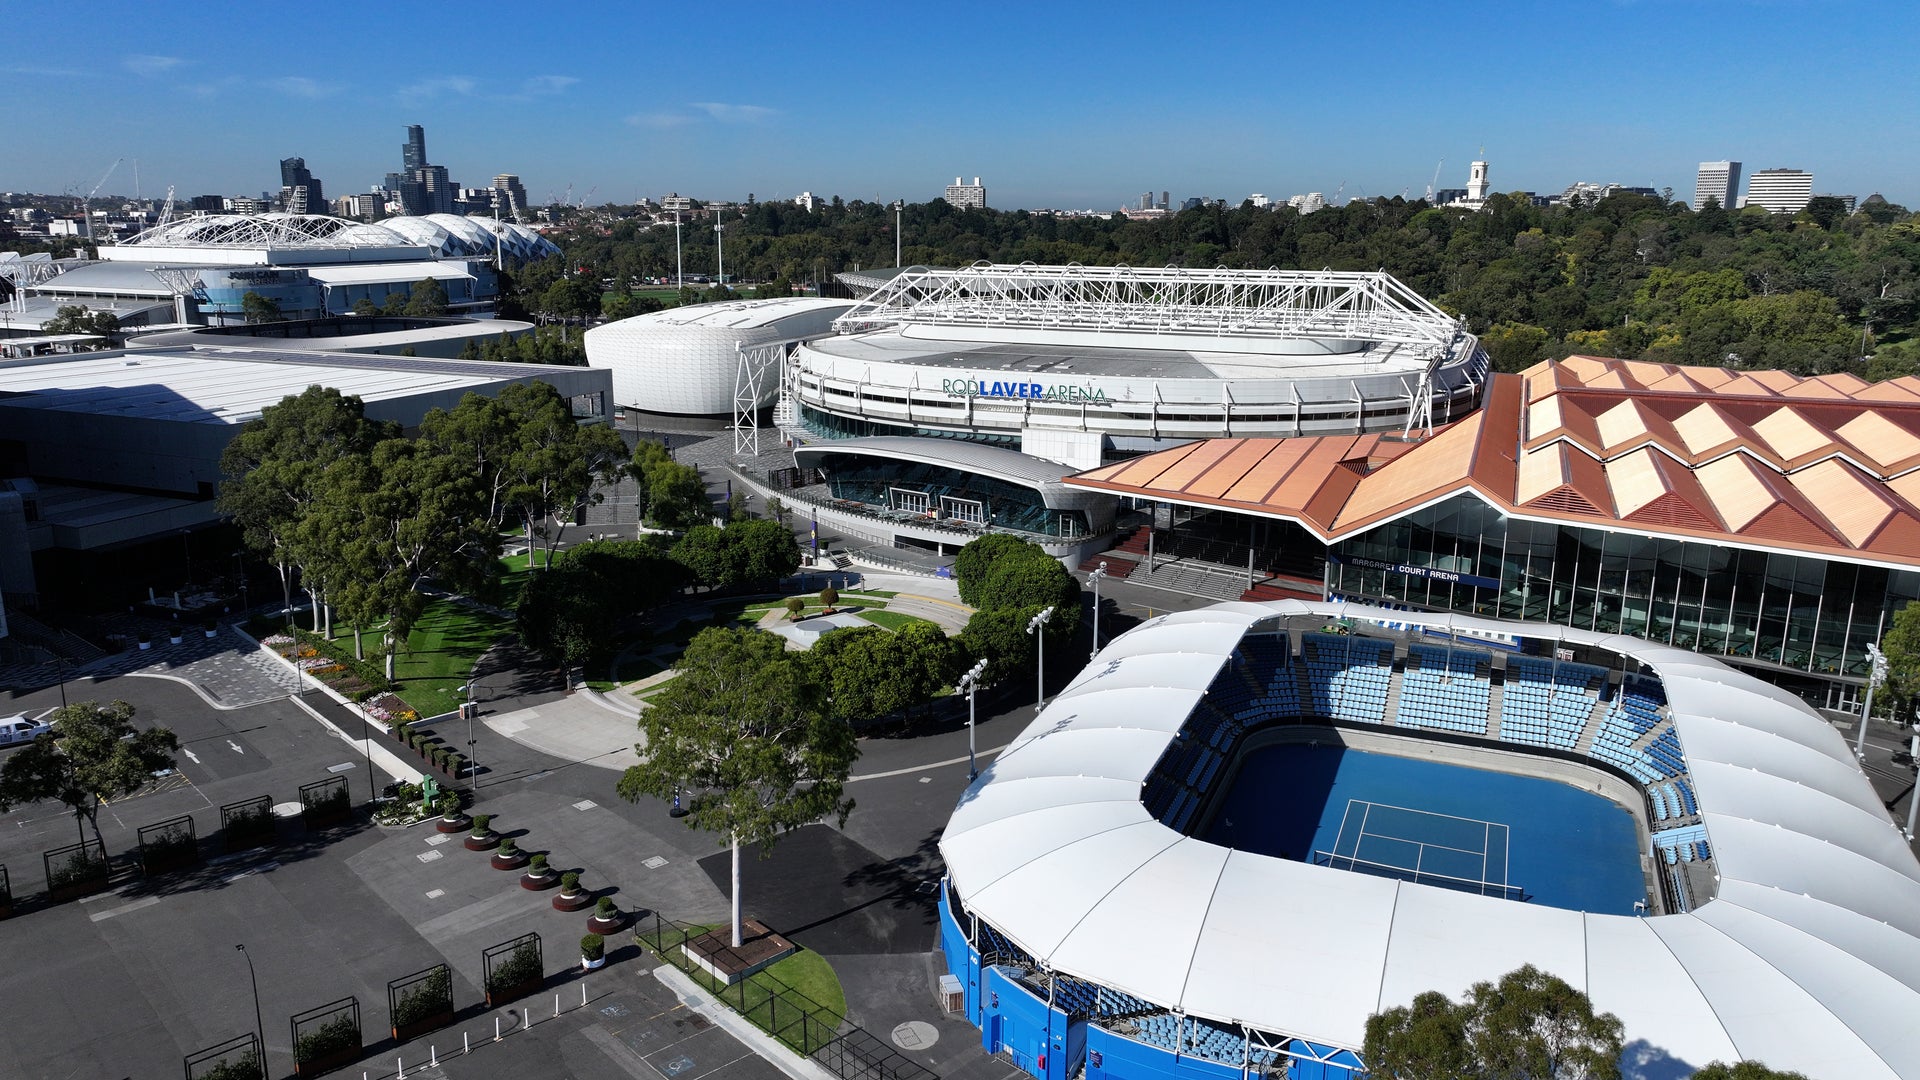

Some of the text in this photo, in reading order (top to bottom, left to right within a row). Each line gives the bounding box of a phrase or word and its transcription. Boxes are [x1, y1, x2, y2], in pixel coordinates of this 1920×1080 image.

[942, 378, 1106, 401] ROD LAVER ARENA
[1352, 558, 1459, 581] MARGARET COURT ARENA
